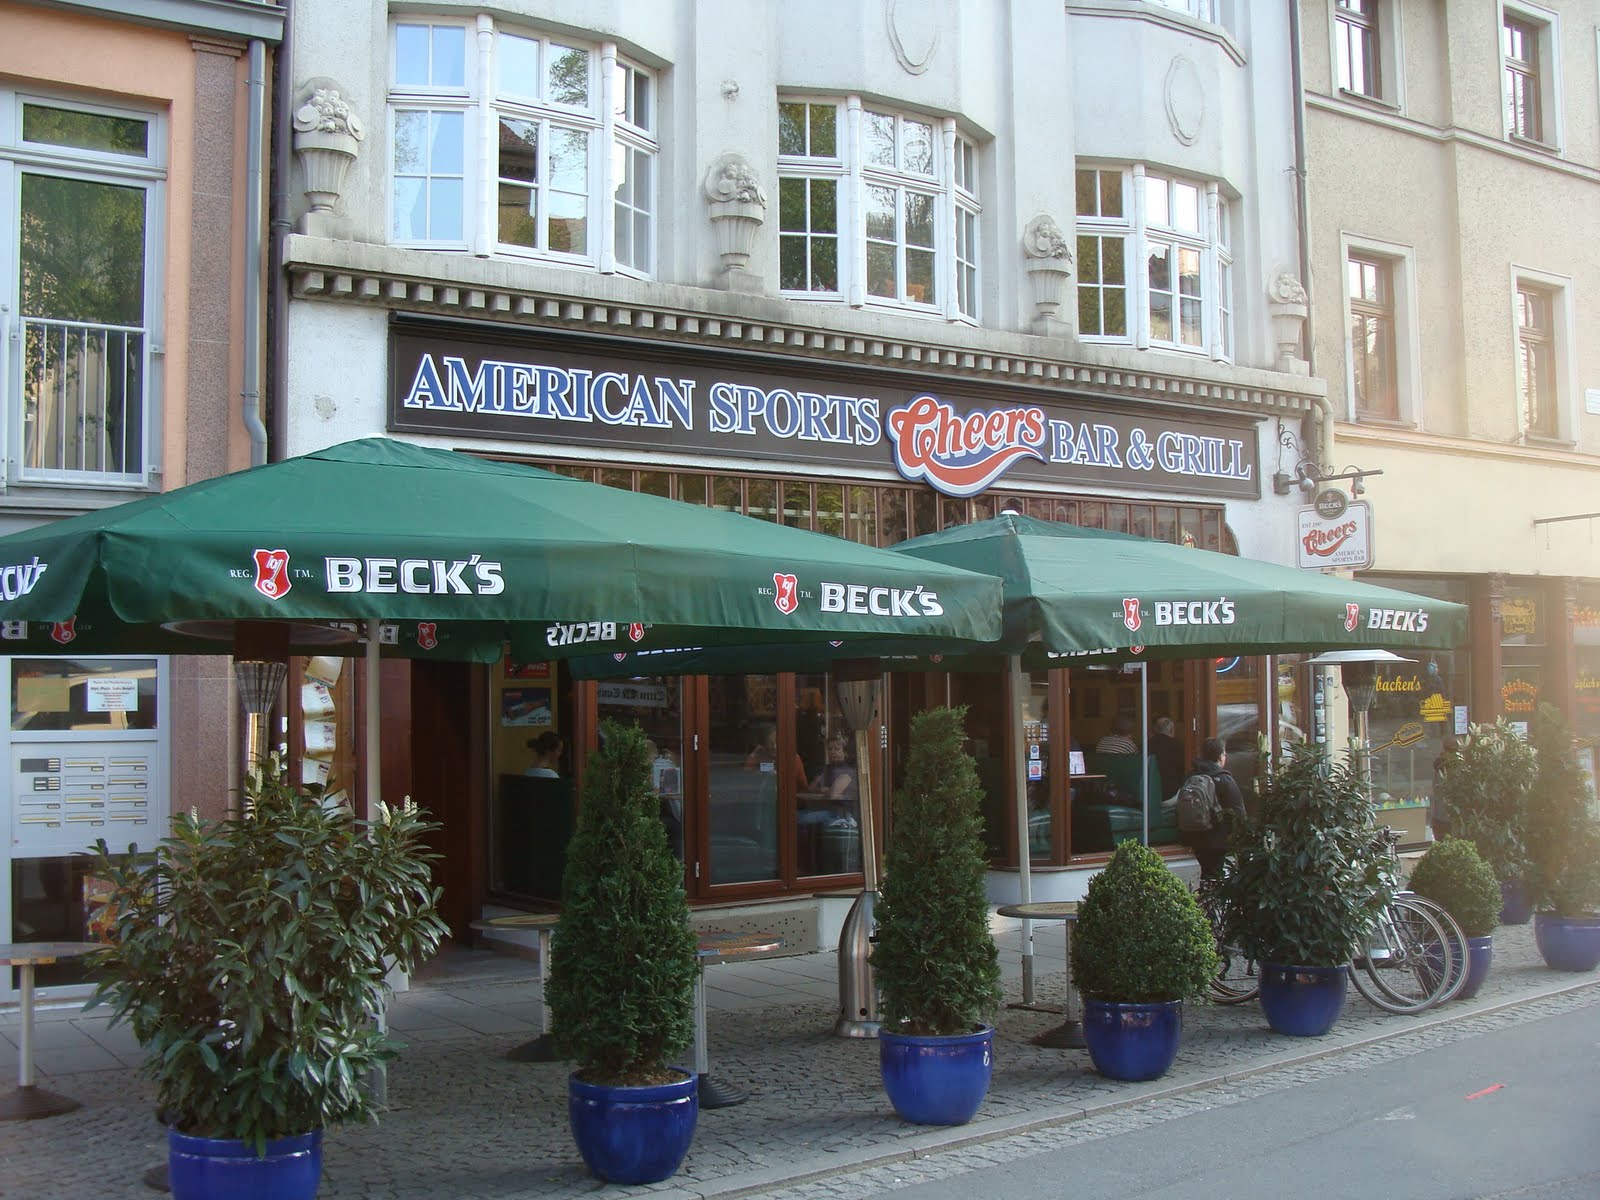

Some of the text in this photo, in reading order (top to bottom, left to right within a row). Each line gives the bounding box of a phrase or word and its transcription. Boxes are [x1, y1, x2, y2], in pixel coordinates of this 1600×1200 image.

[404, 353, 880, 446] AMERICAN SPORTS
[889, 395, 1046, 488] Cheers
[1048, 419, 1252, 480] BAR & GRILL
[1302, 520, 1357, 557] Cheers
[229, 554, 505, 596] REG. TM. BECK'S
[819, 582, 945, 617] BECK'S
[1154, 597, 1235, 626] BECK'S
[1366, 608, 1429, 633] BECK'S
[1375, 675, 1421, 692] backen's
